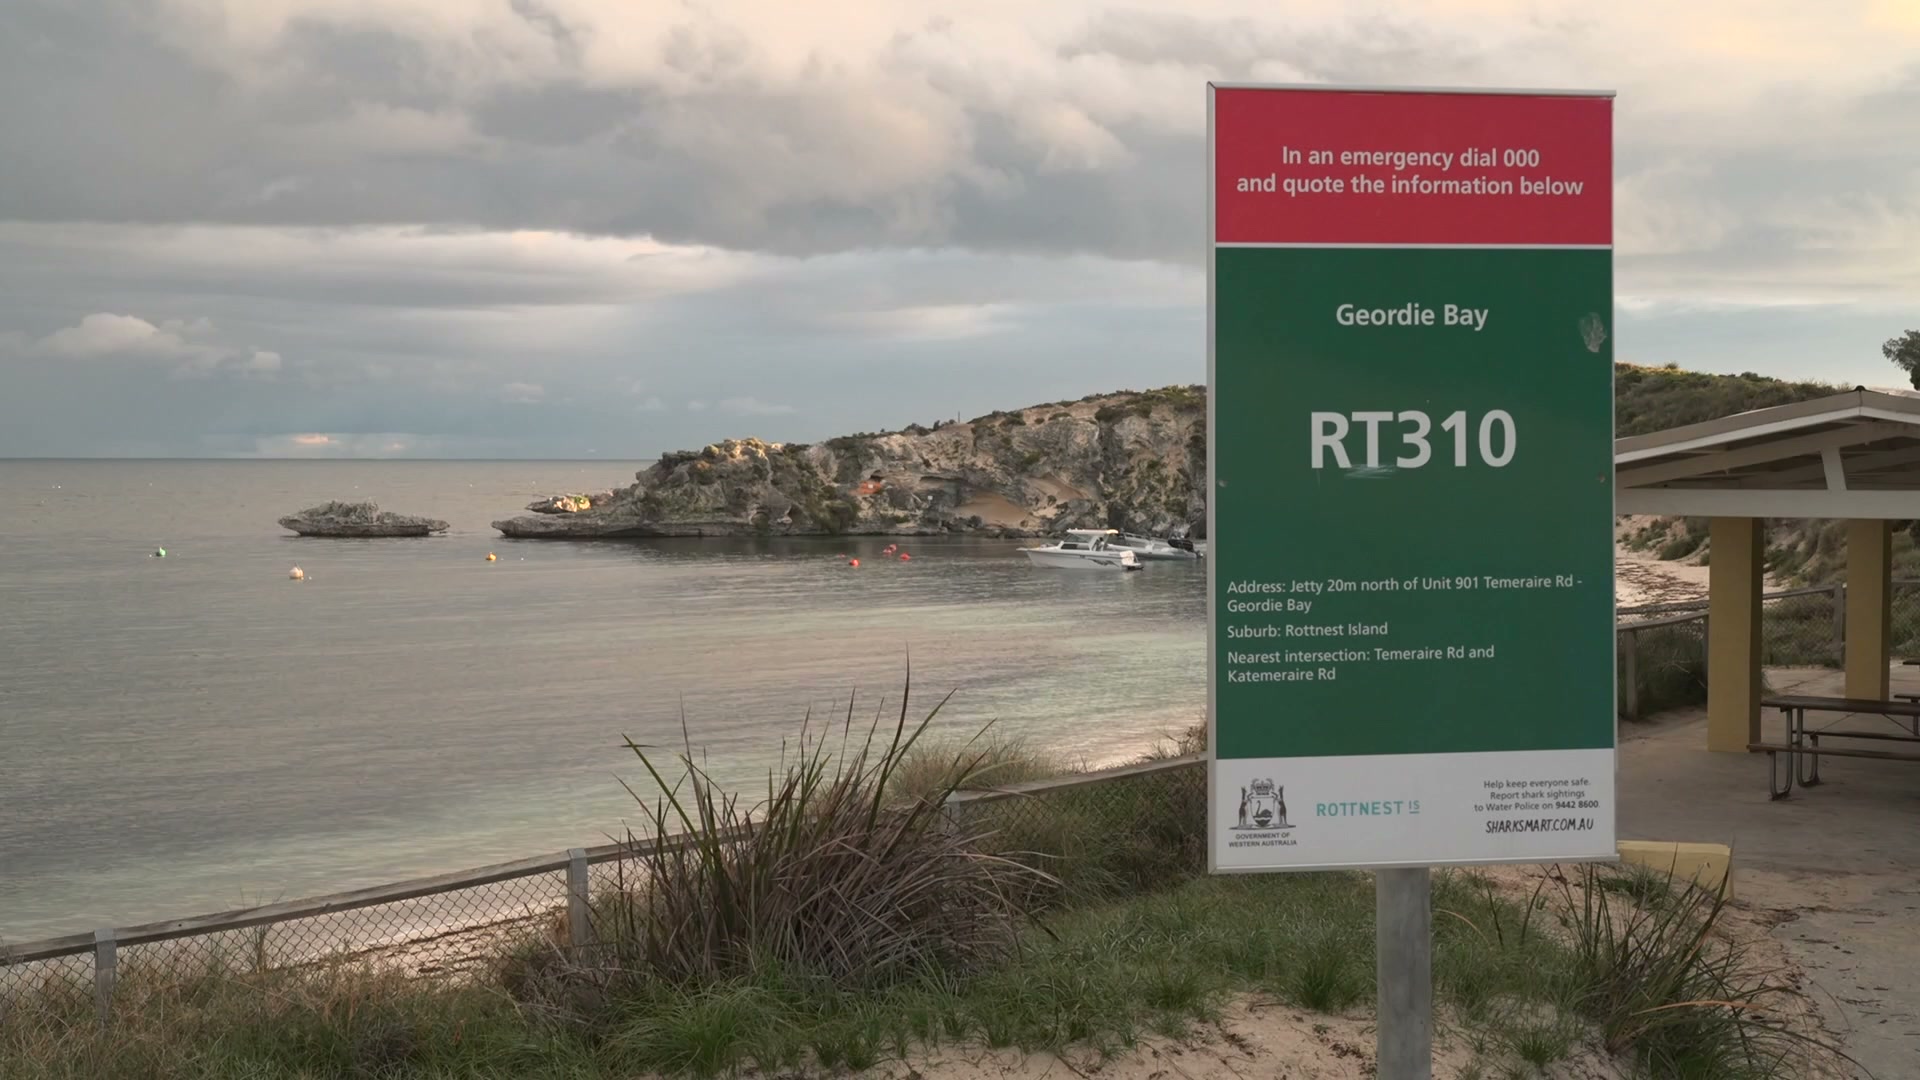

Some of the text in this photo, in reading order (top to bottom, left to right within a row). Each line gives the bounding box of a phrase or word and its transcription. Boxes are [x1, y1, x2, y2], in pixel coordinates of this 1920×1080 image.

[1282, 146, 1540, 171] In an emergency dial 000
[1236, 173, 1583, 197] and quote the information below
[1336, 302, 1489, 331] Geordie Bay
[1310, 409, 1517, 469] RT310
[1227, 580, 1286, 595] Address:
[1290, 579, 1324, 595] Jetty
[1327, 578, 1357, 593] 20m
[1360, 577, 1399, 592] north
[1402, 576, 1419, 591] of
[1422, 576, 1452, 591] Unit
[1455, 576, 1480, 590] 901
[1483, 575, 1552, 589] Temeraire
[1555, 573, 1573, 588] Rd
[1227, 598, 1312, 614] Geordie Bay
[1227, 622, 1388, 639] Suburb: Rottnest Island
[1228, 644, 1495, 664] Nearest intersection: Temeraire Rd and
[1228, 667, 1336, 684] Katemeraire Rd
[1483, 779, 1504, 790] Help
[1506, 779, 1527, 789] keep
[1529, 778, 1569, 788] everyone
[1490, 789, 1585, 801] Report shark sightings
[1316, 800, 1421, 817] ROTTNEST IS
[1474, 804, 1484, 812] to
[1485, 803, 1512, 811] Water
[1514, 802, 1539, 811] Police
[1555, 801, 1576, 809] 9442
[1485, 818, 1594, 834] SHARKSMART.COM.AU
[1228, 839, 1297, 848] WESTERN AUSTRALIA
